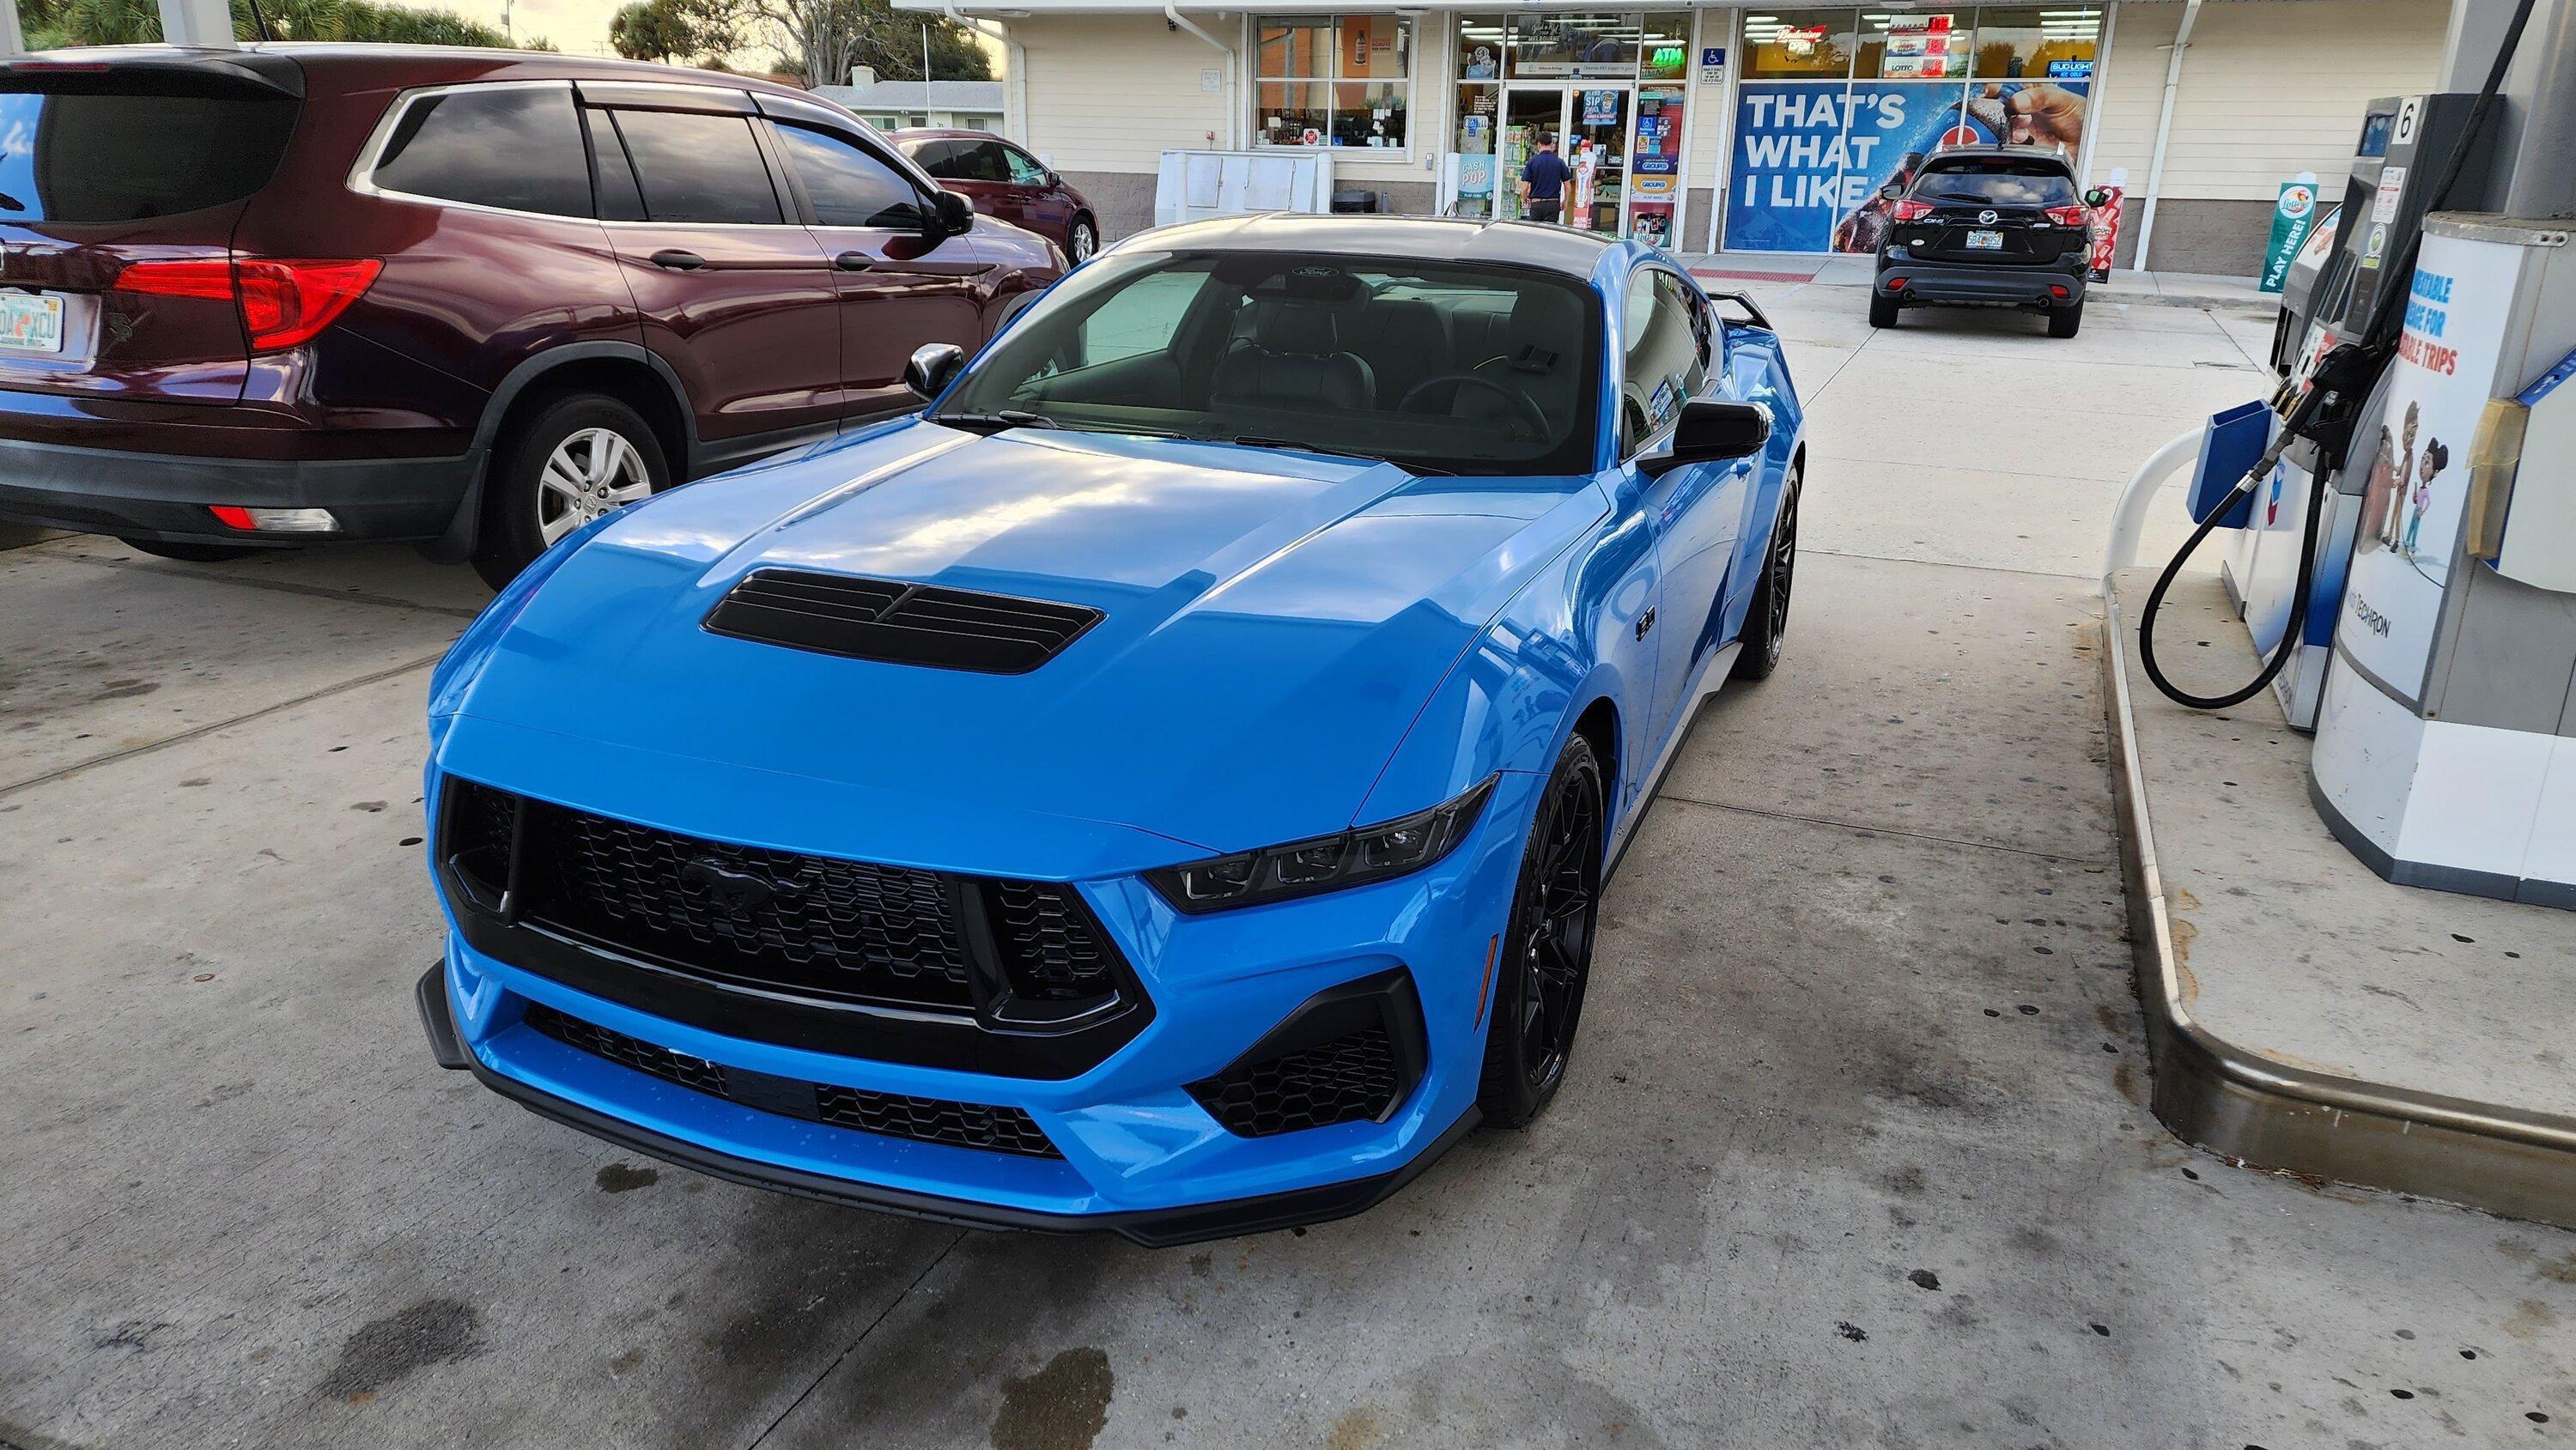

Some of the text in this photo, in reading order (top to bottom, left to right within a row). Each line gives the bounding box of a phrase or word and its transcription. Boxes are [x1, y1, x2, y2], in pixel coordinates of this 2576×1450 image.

[1652, 48, 1684, 64] ATM
[1788, 41, 1813, 53] OPEN
[2401, 103, 2414, 138] 6
[1462, 161, 1485, 173] CASH
[1745, 136, 1880, 169] WHAT
[1461, 171, 1486, 185] POP
[1745, 174, 1868, 208] I LIKE
[2265, 219, 2306, 288] PLAY HERE!
[2421, 342, 2458, 375] TRIPS
[2355, 592, 2391, 638] TECHRON
